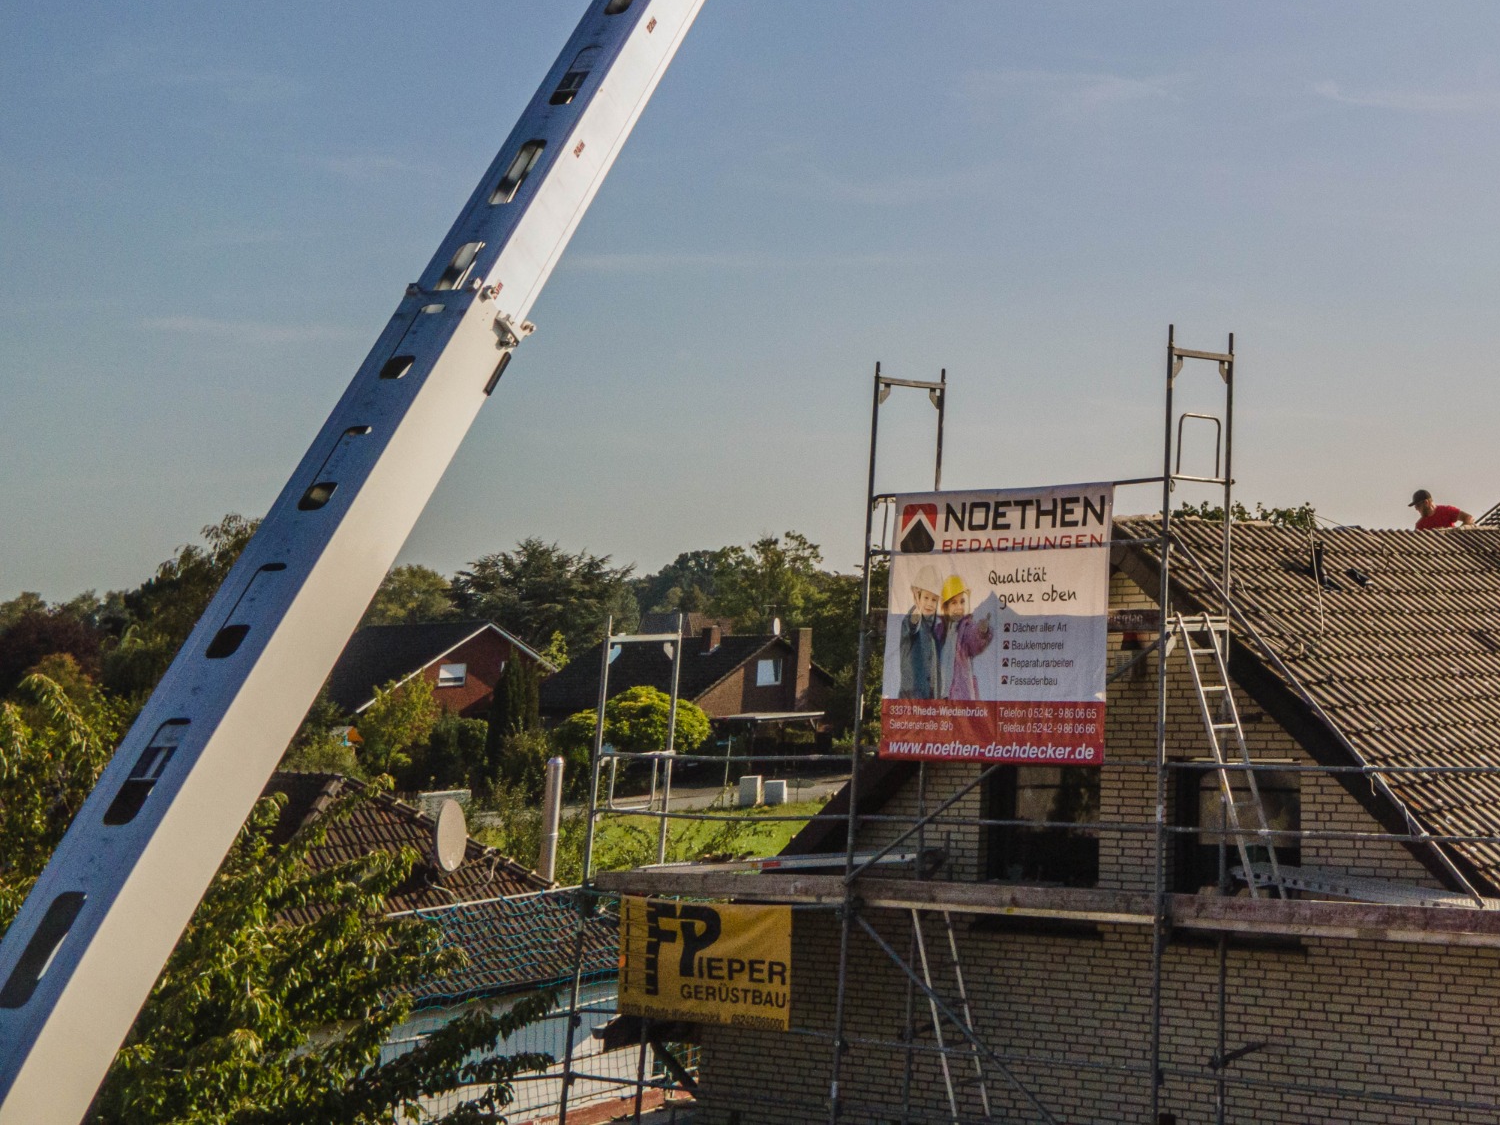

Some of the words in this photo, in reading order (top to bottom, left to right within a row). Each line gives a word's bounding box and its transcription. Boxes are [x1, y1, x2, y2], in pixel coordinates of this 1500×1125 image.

[943, 494, 1107, 533] NOETHEN
[941, 533, 1104, 554] BEDACHUNGEN
[988, 566, 1048, 586] Qualität
[998, 591, 1035, 610] ganz
[1041, 584, 1077, 602] oben
[1012, 622, 1038, 633] Dächer
[1039, 622, 1056, 633] aller
[1057, 621, 1068, 632] Art
[1011, 639, 1065, 652] Bauklempnerei
[1010, 657, 1074, 670] Reparaturarbeiten
[1009, 675, 1059, 686] Fassadenbau
[912, 706, 988, 719] Rheda-Wiedenbrück
[999, 707, 1027, 718] Telefon
[998, 721, 1025, 732] Telefax
[888, 739, 1095, 760] www.noethen-dachdecker.de
[680, 983, 787, 1009] GERÜSTBAU
